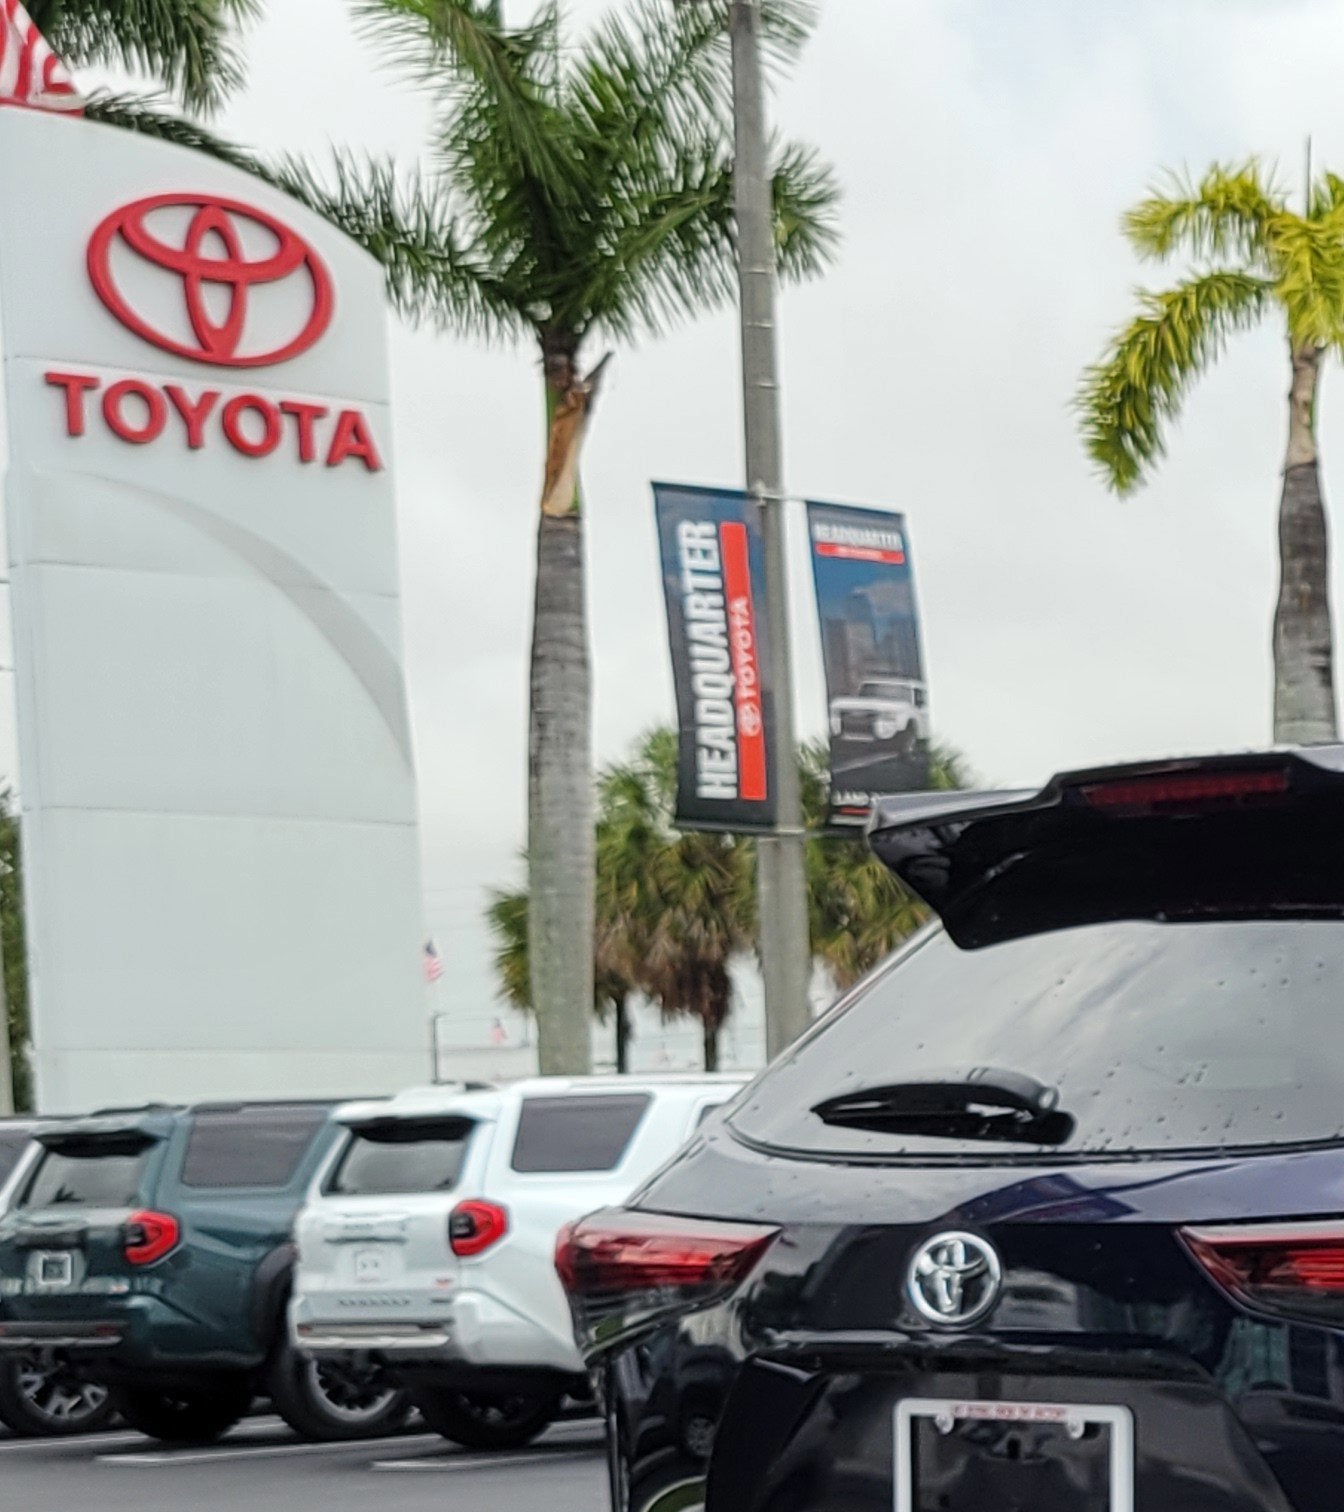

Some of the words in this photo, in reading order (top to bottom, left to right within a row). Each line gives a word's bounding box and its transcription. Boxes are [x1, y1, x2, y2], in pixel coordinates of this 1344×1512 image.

[45, 371, 383, 473] TOYOTA
[677, 519, 739, 800] HEADQUARTER
[728, 596, 760, 701] TOYOTA
